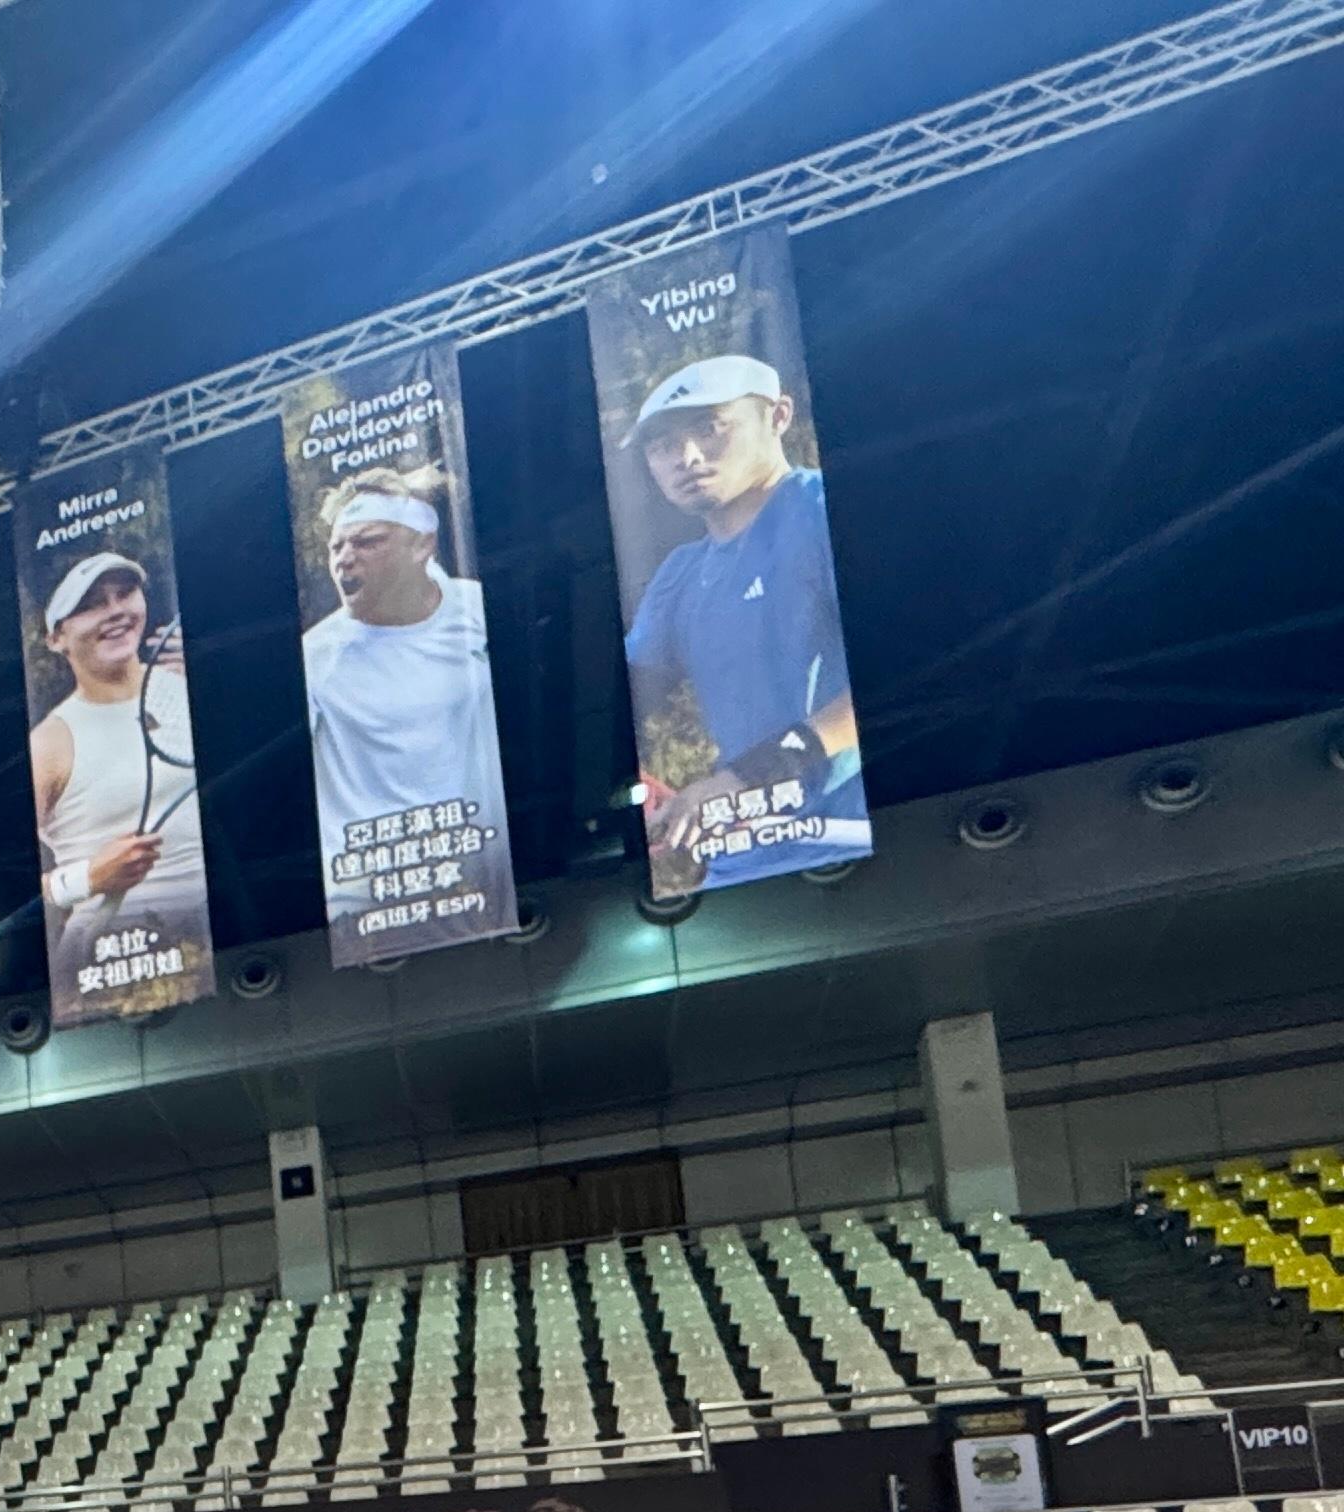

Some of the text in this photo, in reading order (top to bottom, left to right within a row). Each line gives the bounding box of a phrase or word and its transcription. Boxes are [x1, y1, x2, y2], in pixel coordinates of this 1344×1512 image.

[639, 272, 736, 316] Yibing
[666, 304, 715, 333] Wu
[309, 380, 433, 434] Alejandro
[302, 398, 444, 460] Davidovich
[331, 432, 418, 474] Fokina
[58, 487, 118, 521] Mirra
[36, 500, 144, 550] Andreeva
[757, 816, 824, 846] CHN)
[436, 892, 486, 917] ESP)
[1238, 1424, 1309, 1450] VIP10
